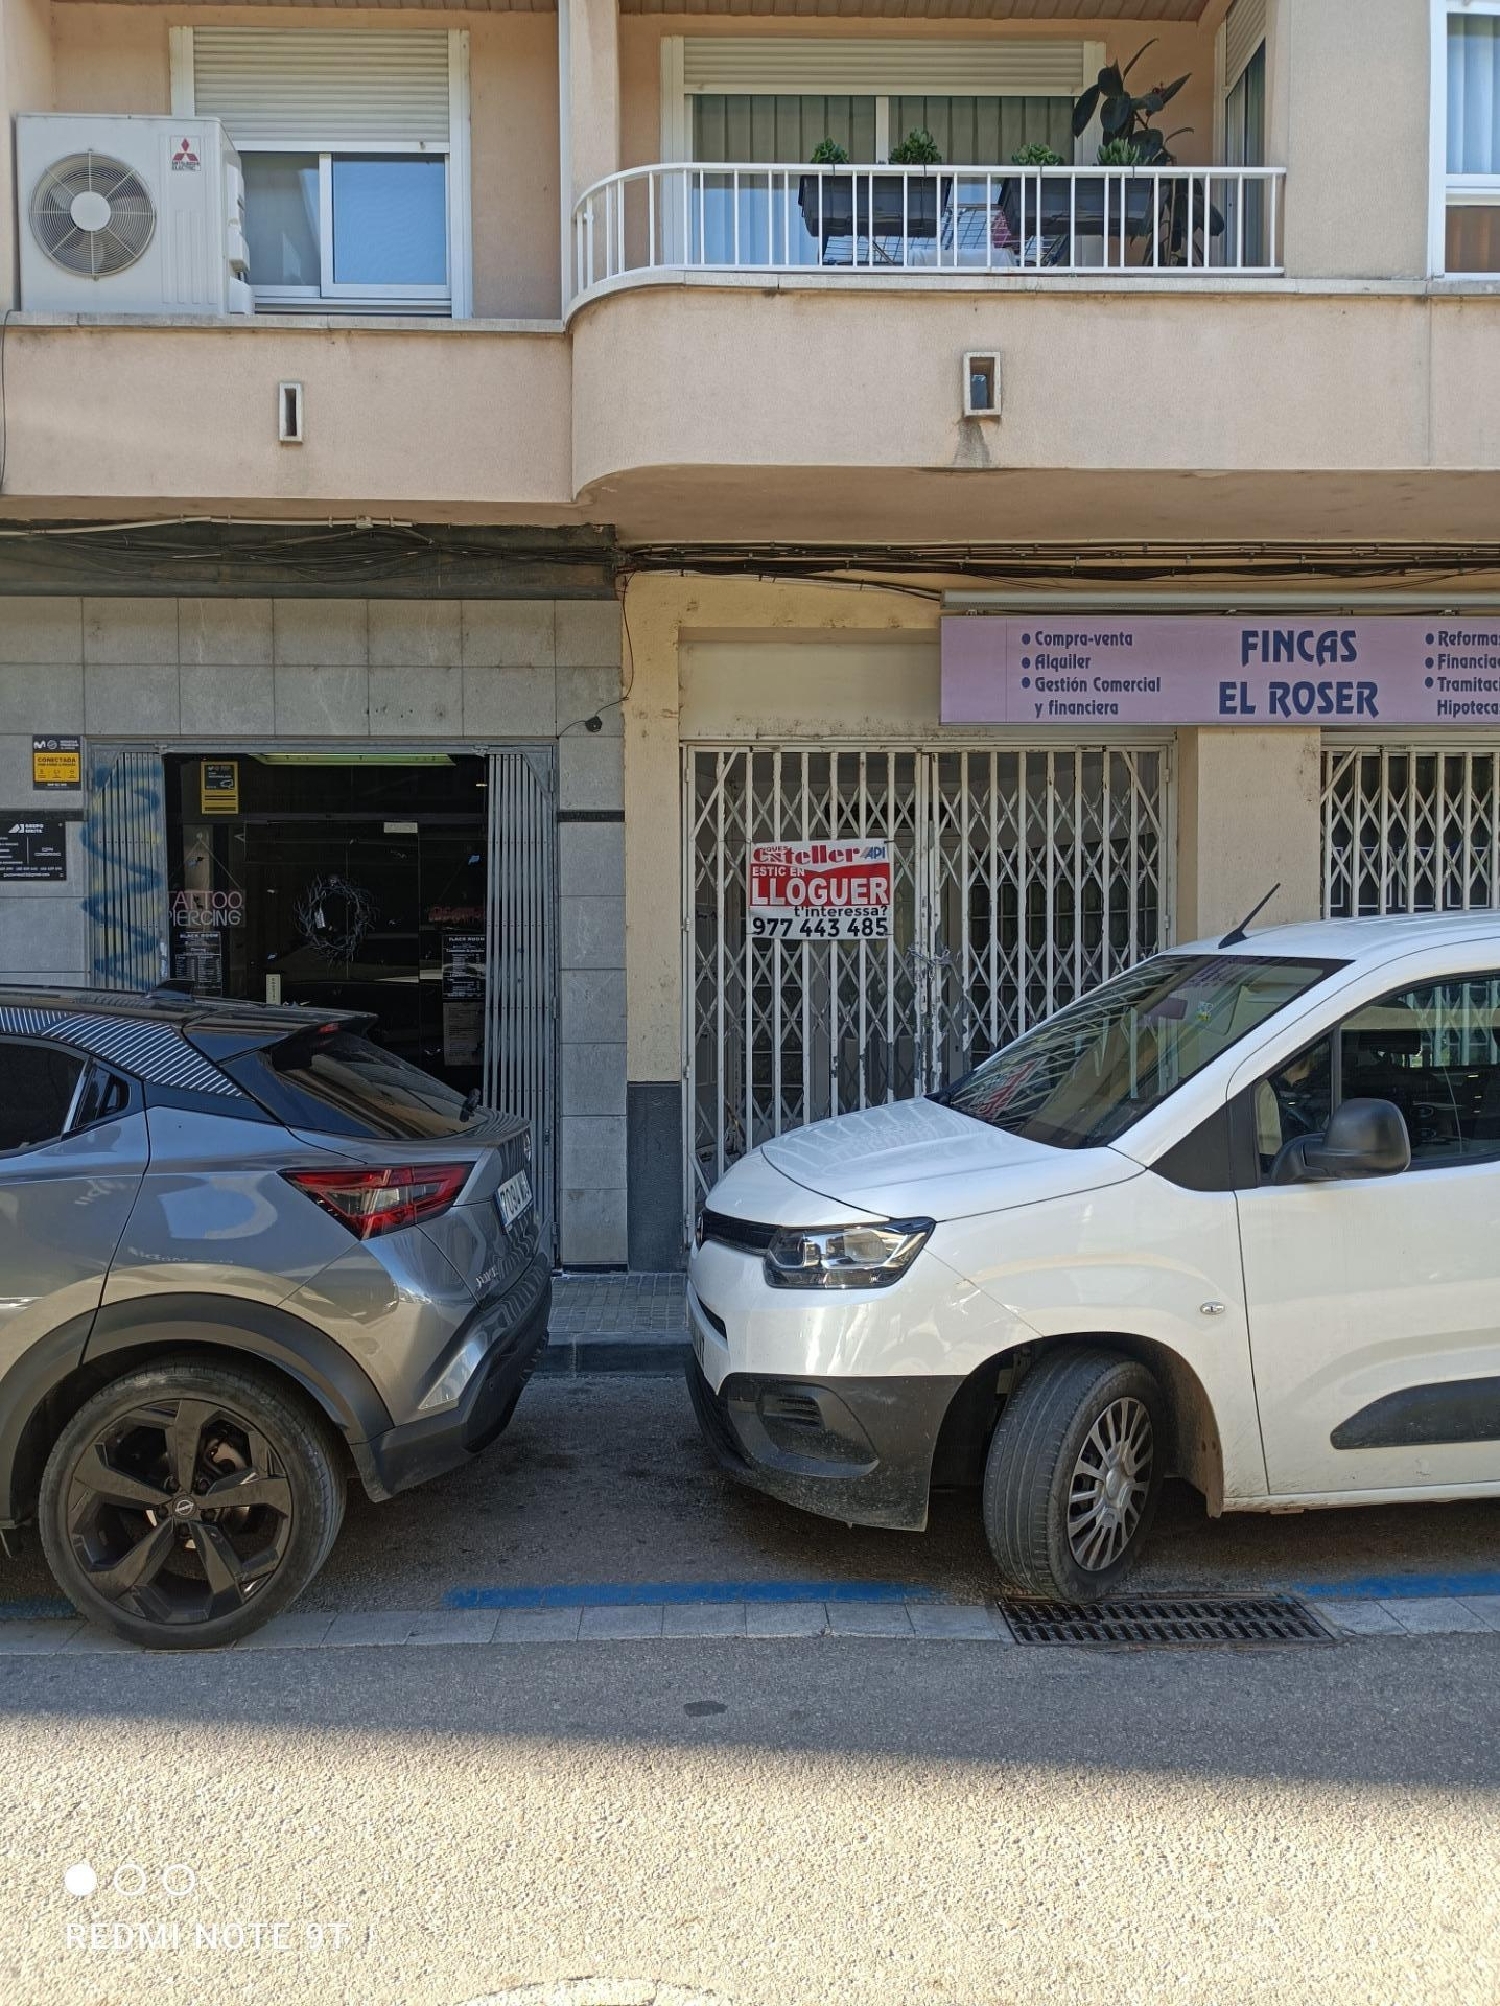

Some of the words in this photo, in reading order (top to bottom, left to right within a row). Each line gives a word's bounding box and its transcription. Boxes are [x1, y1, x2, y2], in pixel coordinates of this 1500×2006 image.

[1035, 631, 1133, 649] Compra-venta
[1438, 631, 1500, 647] Reforma
[1241, 630, 1358, 667] FINCAS
[1035, 654, 1092, 672] Alquiler
[1035, 676, 1088, 692] Gestión
[1093, 676, 1162, 692] Comercial
[1219, 681, 1256, 715] EL
[1269, 681, 1379, 718] ROSER
[1034, 702, 1043, 719] y
[1049, 700, 1119, 715] financiera
[1437, 700, 1500, 718] Hipoteca
[864, 846, 886, 859] API
[752, 866, 787, 877] ESTIC
[790, 866, 805, 877] EN
[752, 877, 889, 905] LLOGUER
[794, 905, 888, 917] t'interessa?
[752, 917, 793, 937] 977
[799, 917, 840, 937] 443
[847, 917, 888, 937] 485
